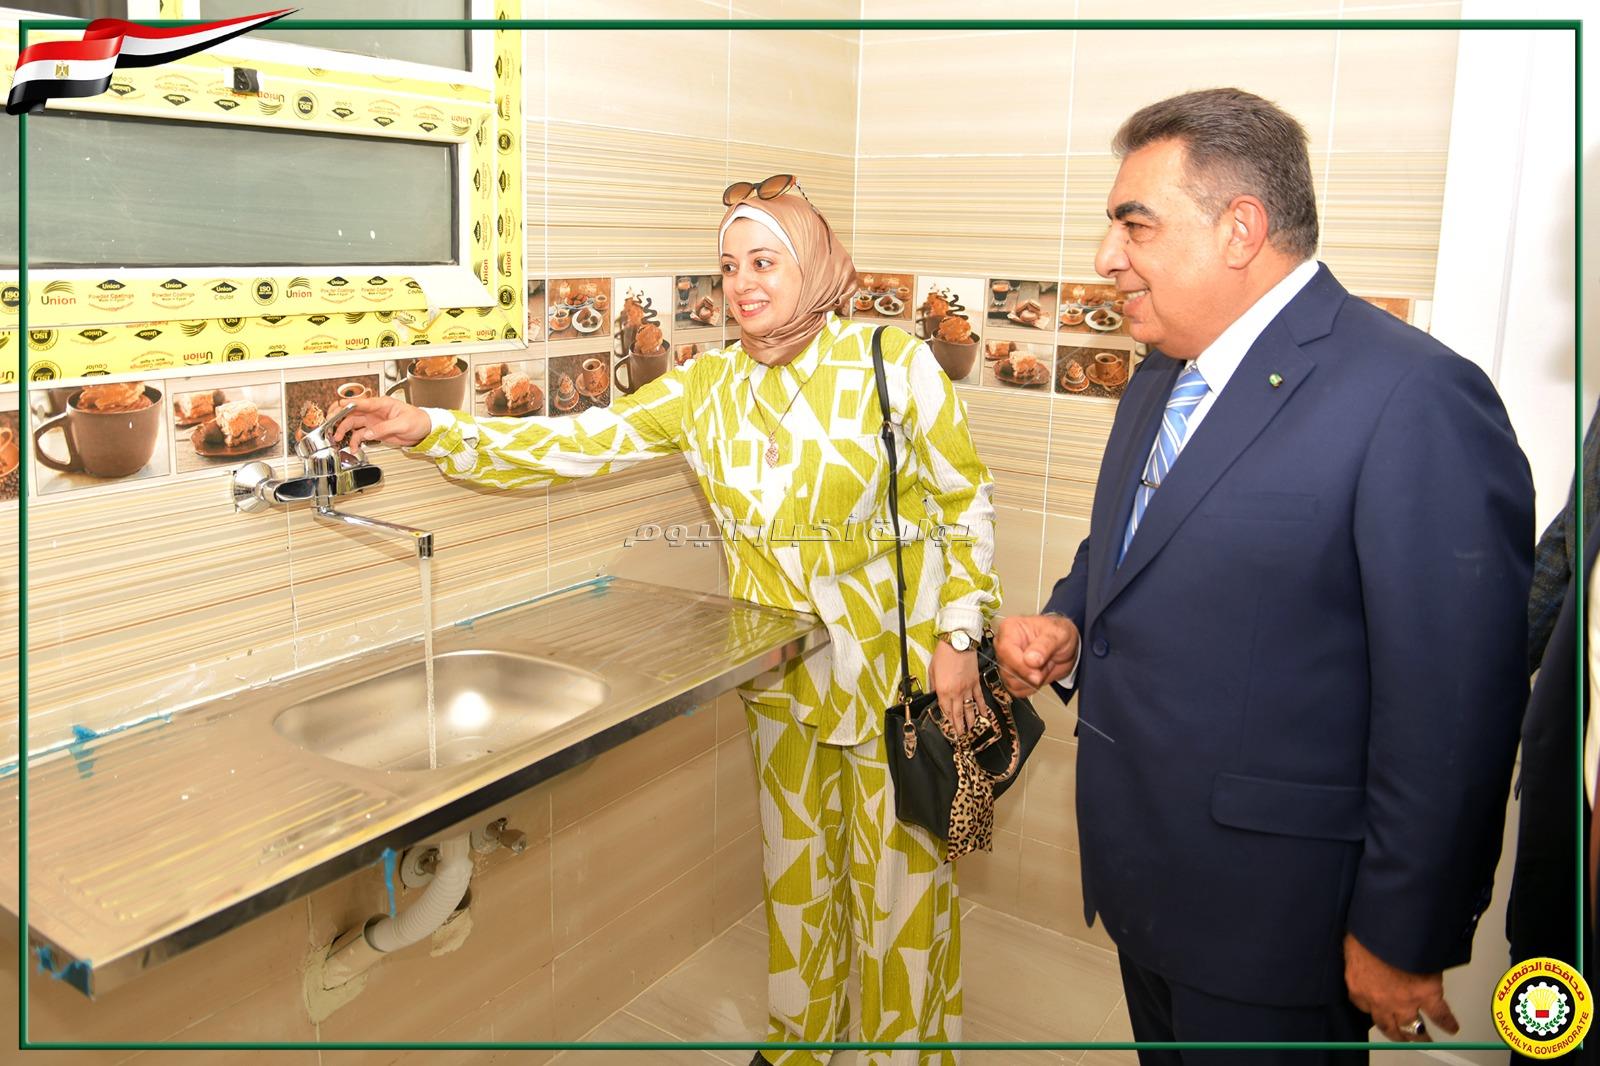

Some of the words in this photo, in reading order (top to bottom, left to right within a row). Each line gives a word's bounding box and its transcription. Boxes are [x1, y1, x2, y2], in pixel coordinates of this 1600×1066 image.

[257, 91, 284, 102] Union
[452, 114, 472, 124] Union
[286, 290, 312, 298] Union
[41, 296, 76, 305] Union
[184, 352, 213, 360] Union
